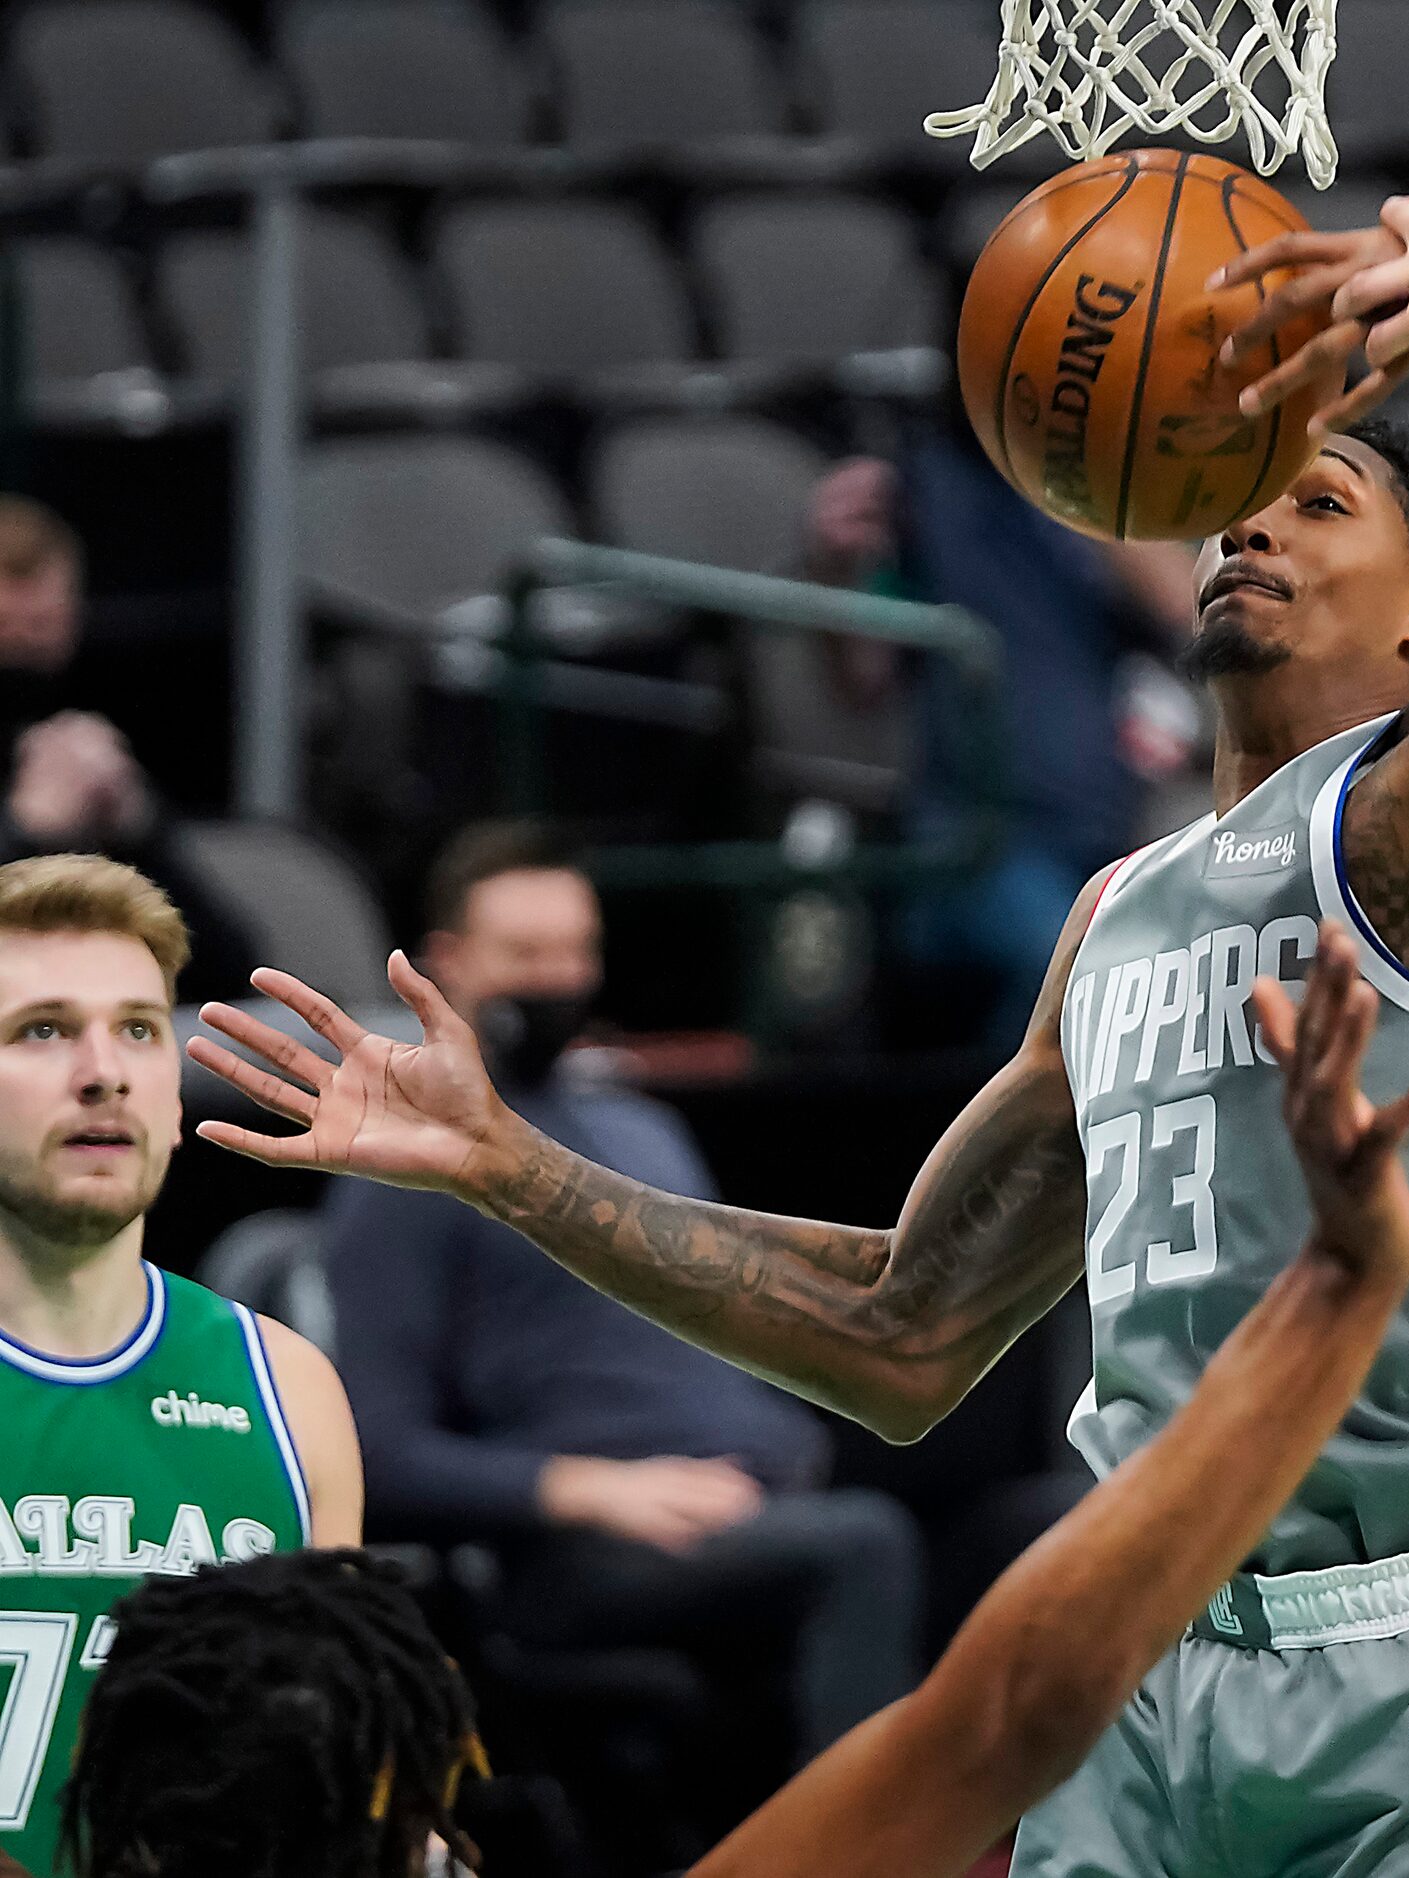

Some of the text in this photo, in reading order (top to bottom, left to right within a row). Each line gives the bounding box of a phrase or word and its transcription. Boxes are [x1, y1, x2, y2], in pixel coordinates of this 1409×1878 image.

[1213, 830, 1297, 866] honey
[1086, 1094, 1218, 1305] 23
[151, 1389, 252, 1434] chime
